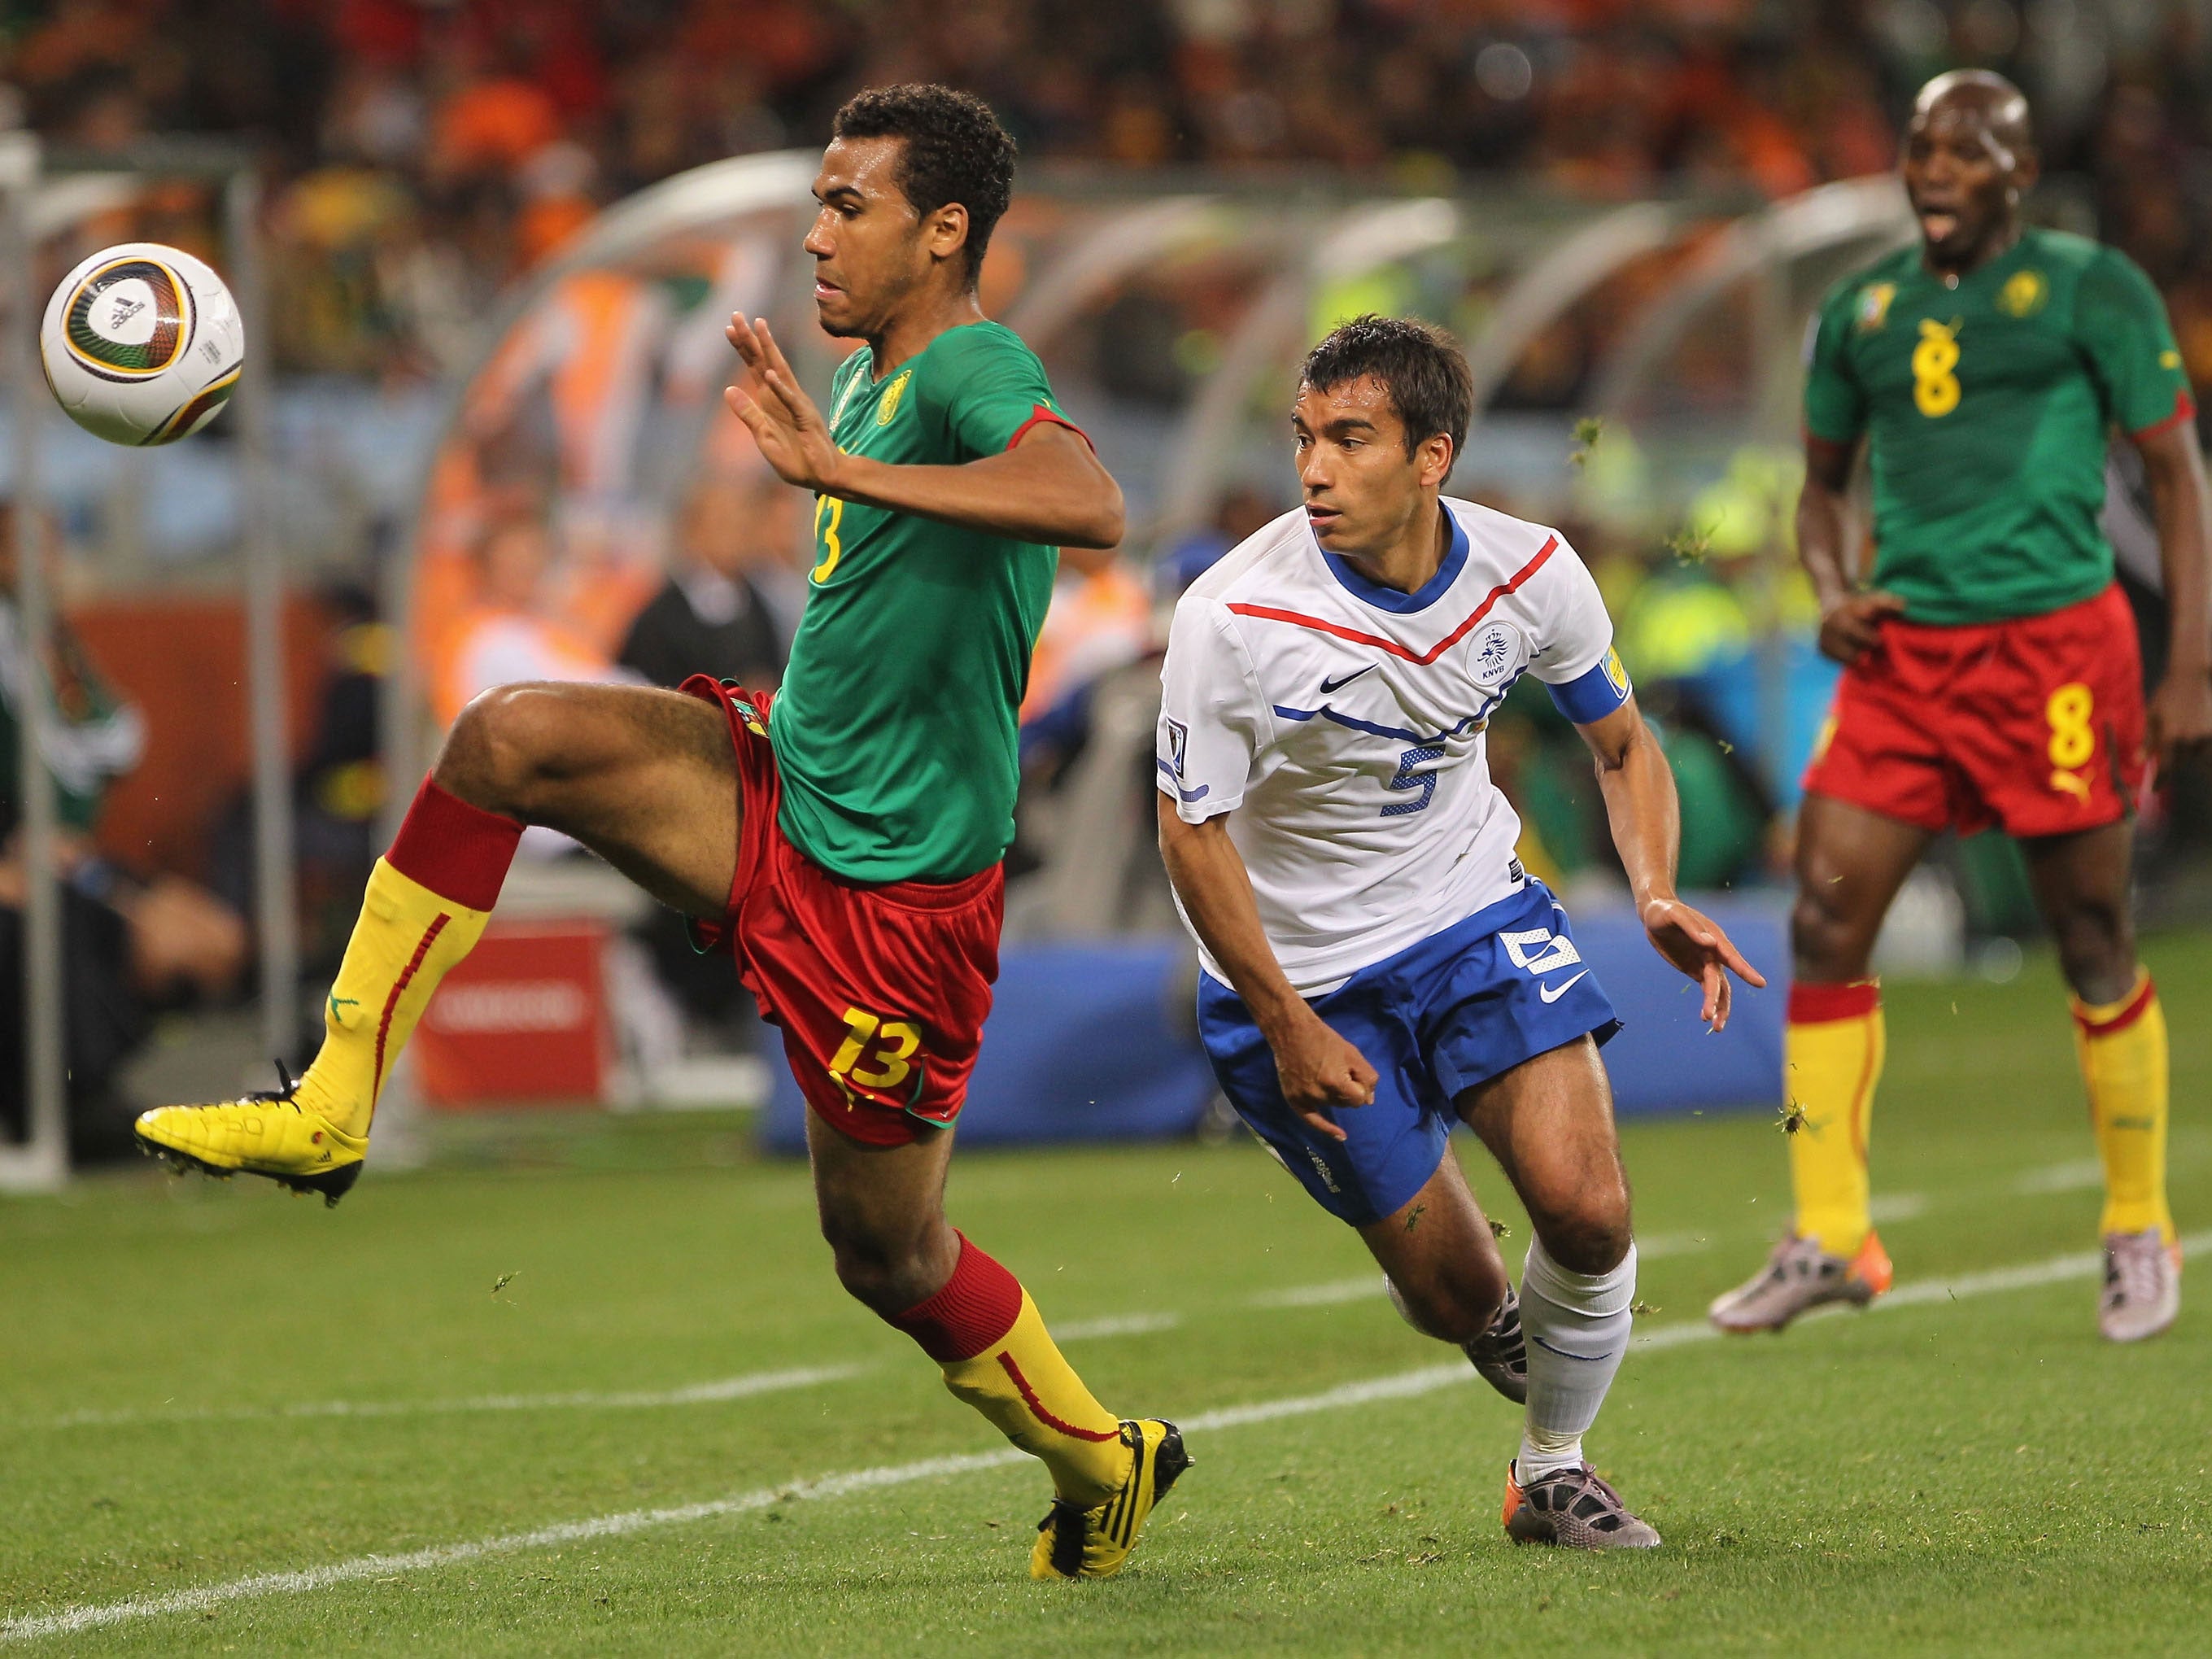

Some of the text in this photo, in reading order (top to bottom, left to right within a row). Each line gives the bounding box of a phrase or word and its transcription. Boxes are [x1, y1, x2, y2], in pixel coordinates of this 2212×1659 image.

[112, 301, 145, 330] adidas
[1912, 337, 1961, 418] 8
[1482, 666, 1505, 679] KNVB
[2046, 682, 2095, 769] 8
[1380, 744, 1446, 817] 5
[1499, 928, 1582, 976] 5
[829, 1007, 922, 1088] 13
